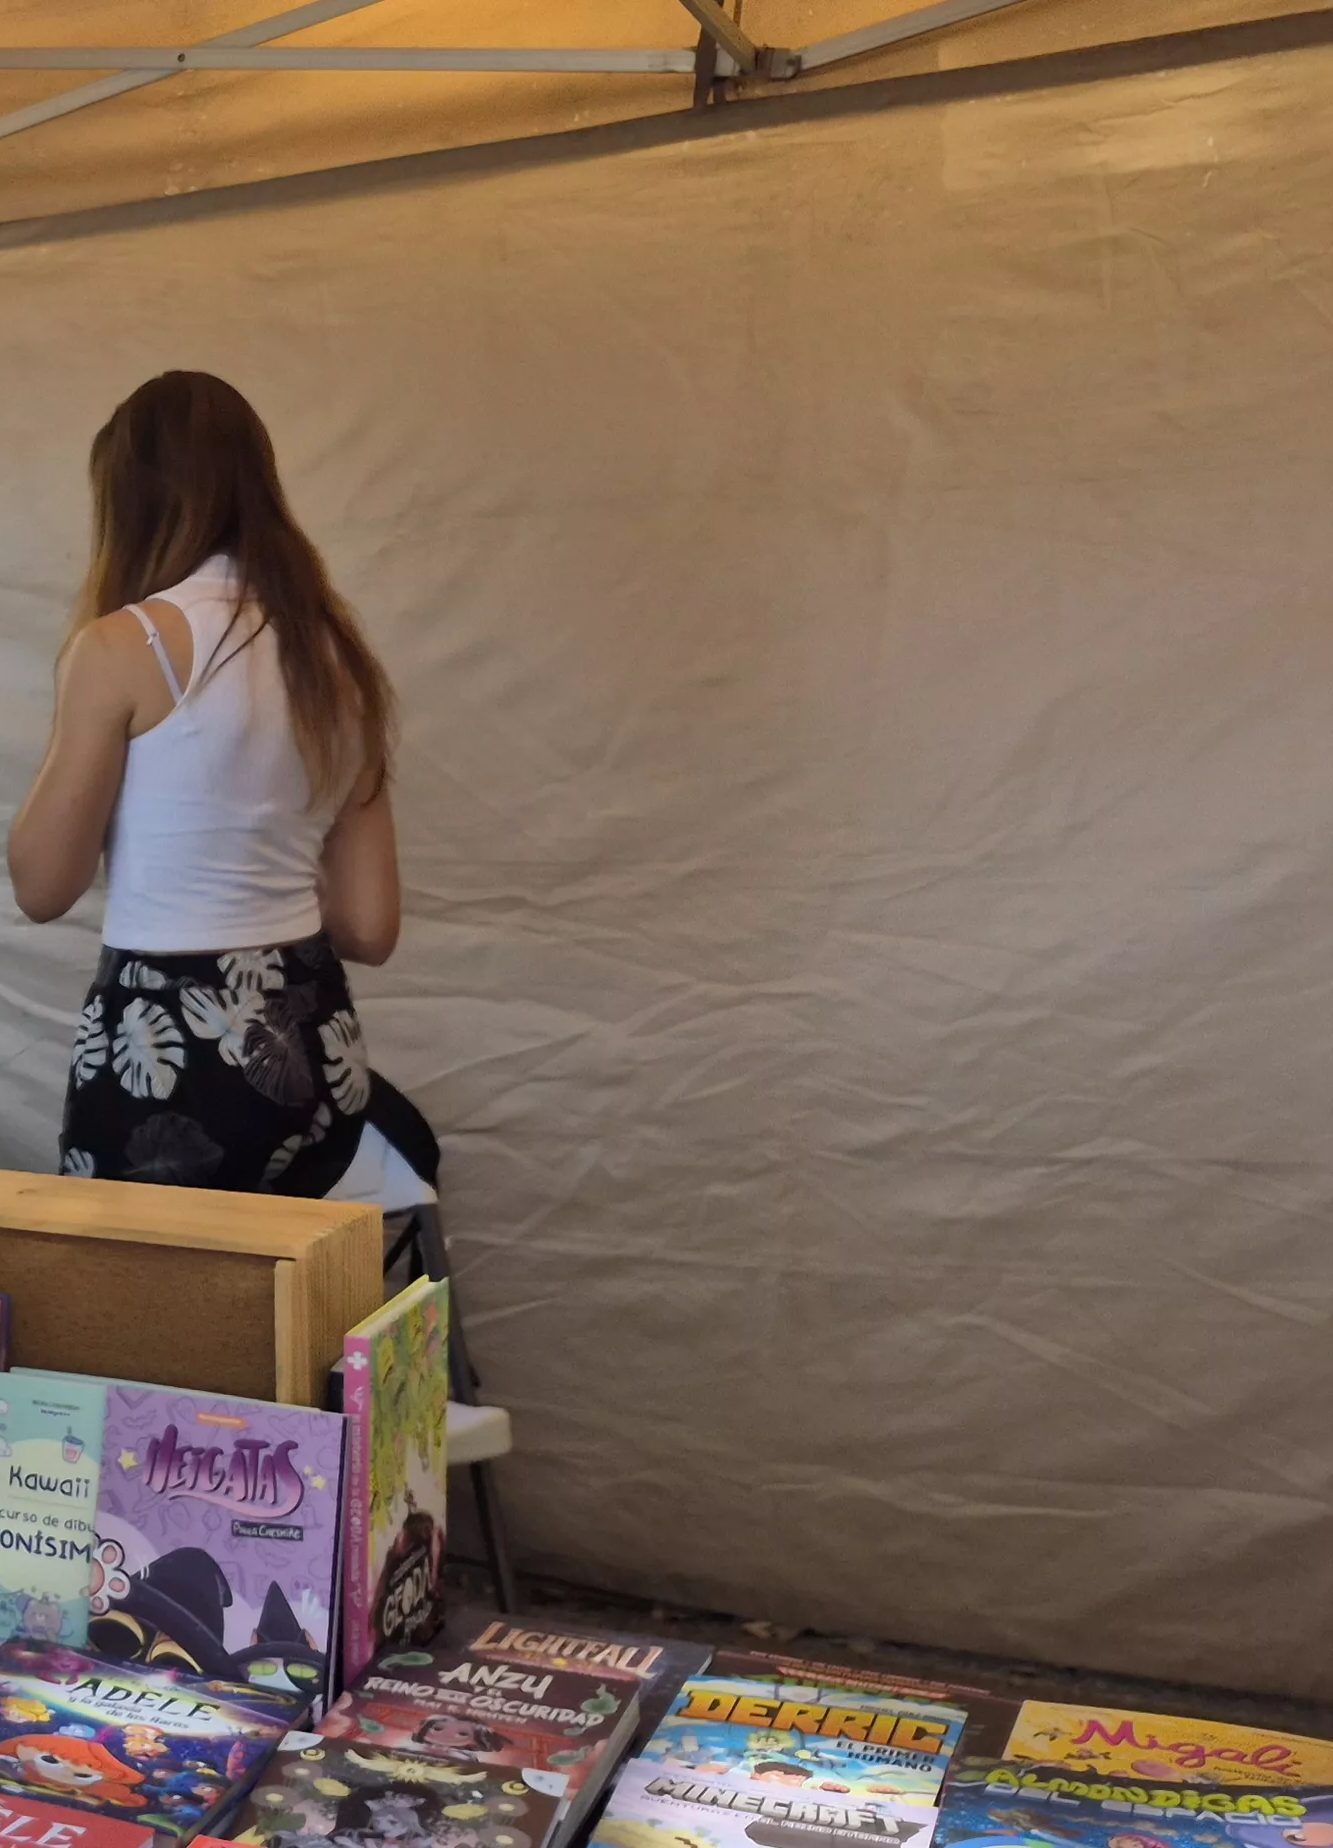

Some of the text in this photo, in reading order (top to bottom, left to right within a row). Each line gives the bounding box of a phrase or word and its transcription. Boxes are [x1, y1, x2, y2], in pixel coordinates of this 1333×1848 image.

[9, 1465, 91, 1499] Kawaii
[42, 1512, 61, 1528] de
[469, 1621, 664, 1680] LIGHTFALL
[439, 1662, 554, 1700] ANZU
[364, 1677, 435, 1698] REINO
[469, 1695, 605, 1728] OSCURIDAD
[676, 1691, 952, 1756] DERRIC
[836, 1740, 936, 1763] EL PRIMER
[847, 1752, 933, 1773] HUMANO
[645, 1776, 901, 1835] MINECRAFT
[1100, 1801, 1304, 1830] ESPACIO
